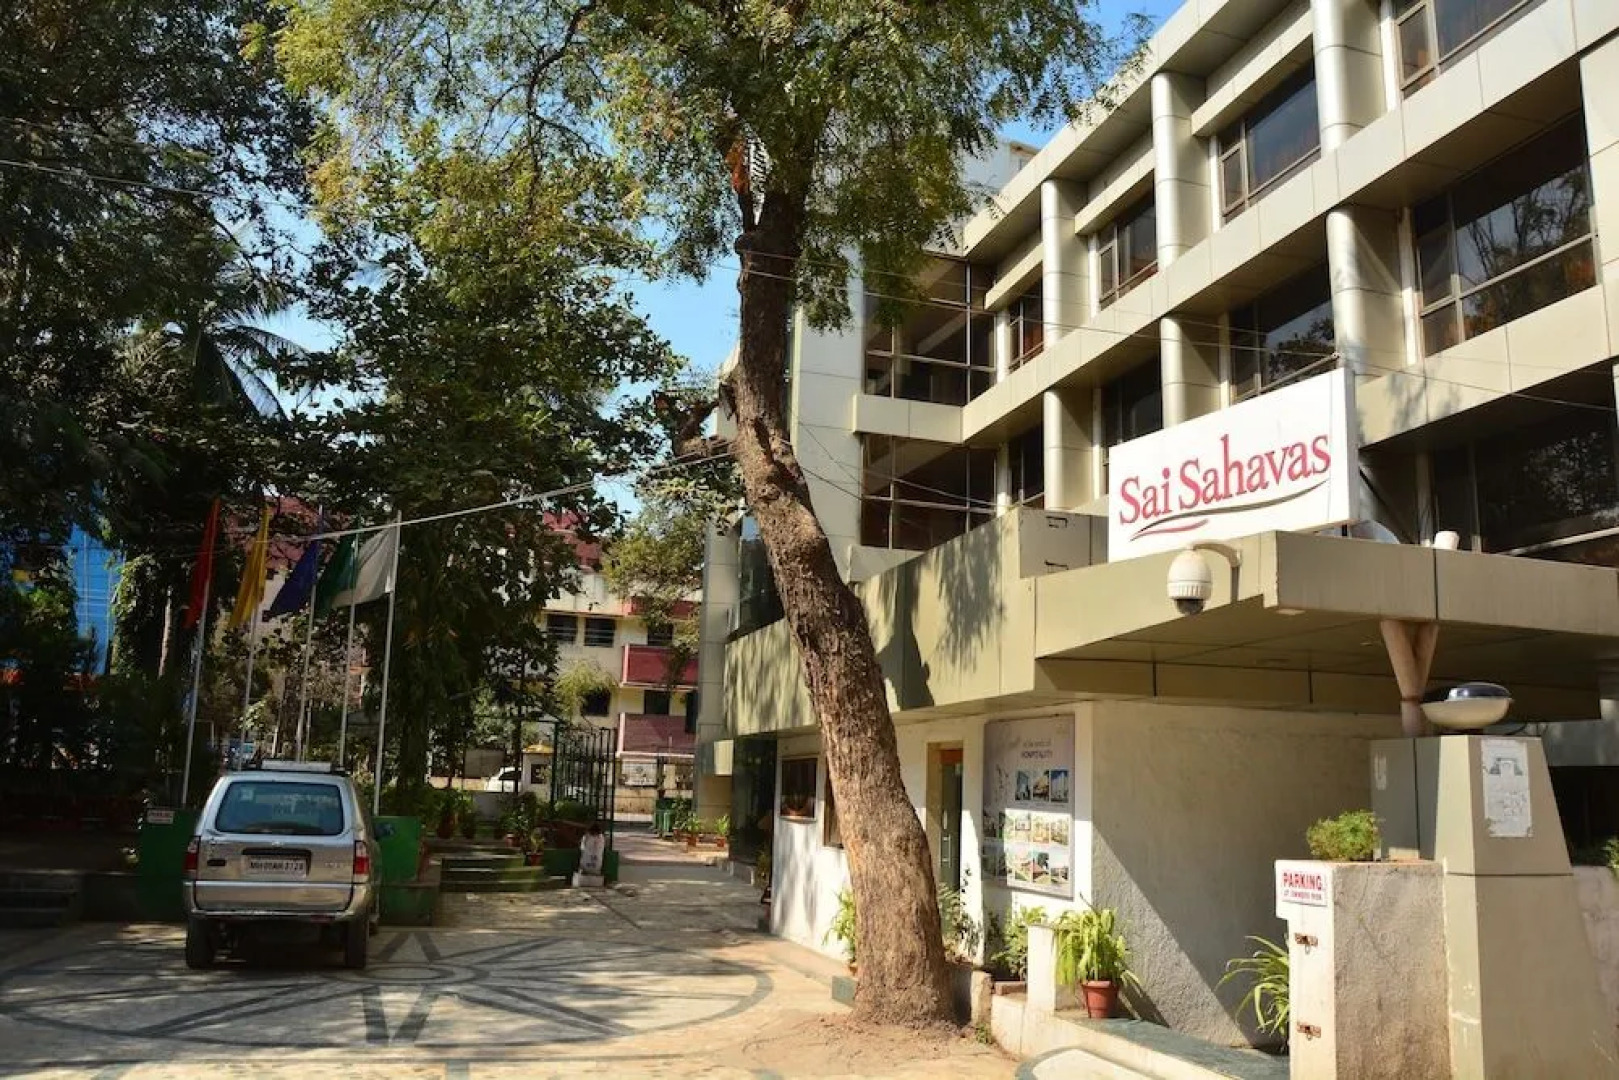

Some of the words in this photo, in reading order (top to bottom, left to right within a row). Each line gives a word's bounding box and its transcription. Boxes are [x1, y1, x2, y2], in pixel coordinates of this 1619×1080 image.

[1119, 467, 1173, 525] Sai
[1178, 433, 1332, 510] Sahavas
[1283, 872, 1322, 891] PARKING
